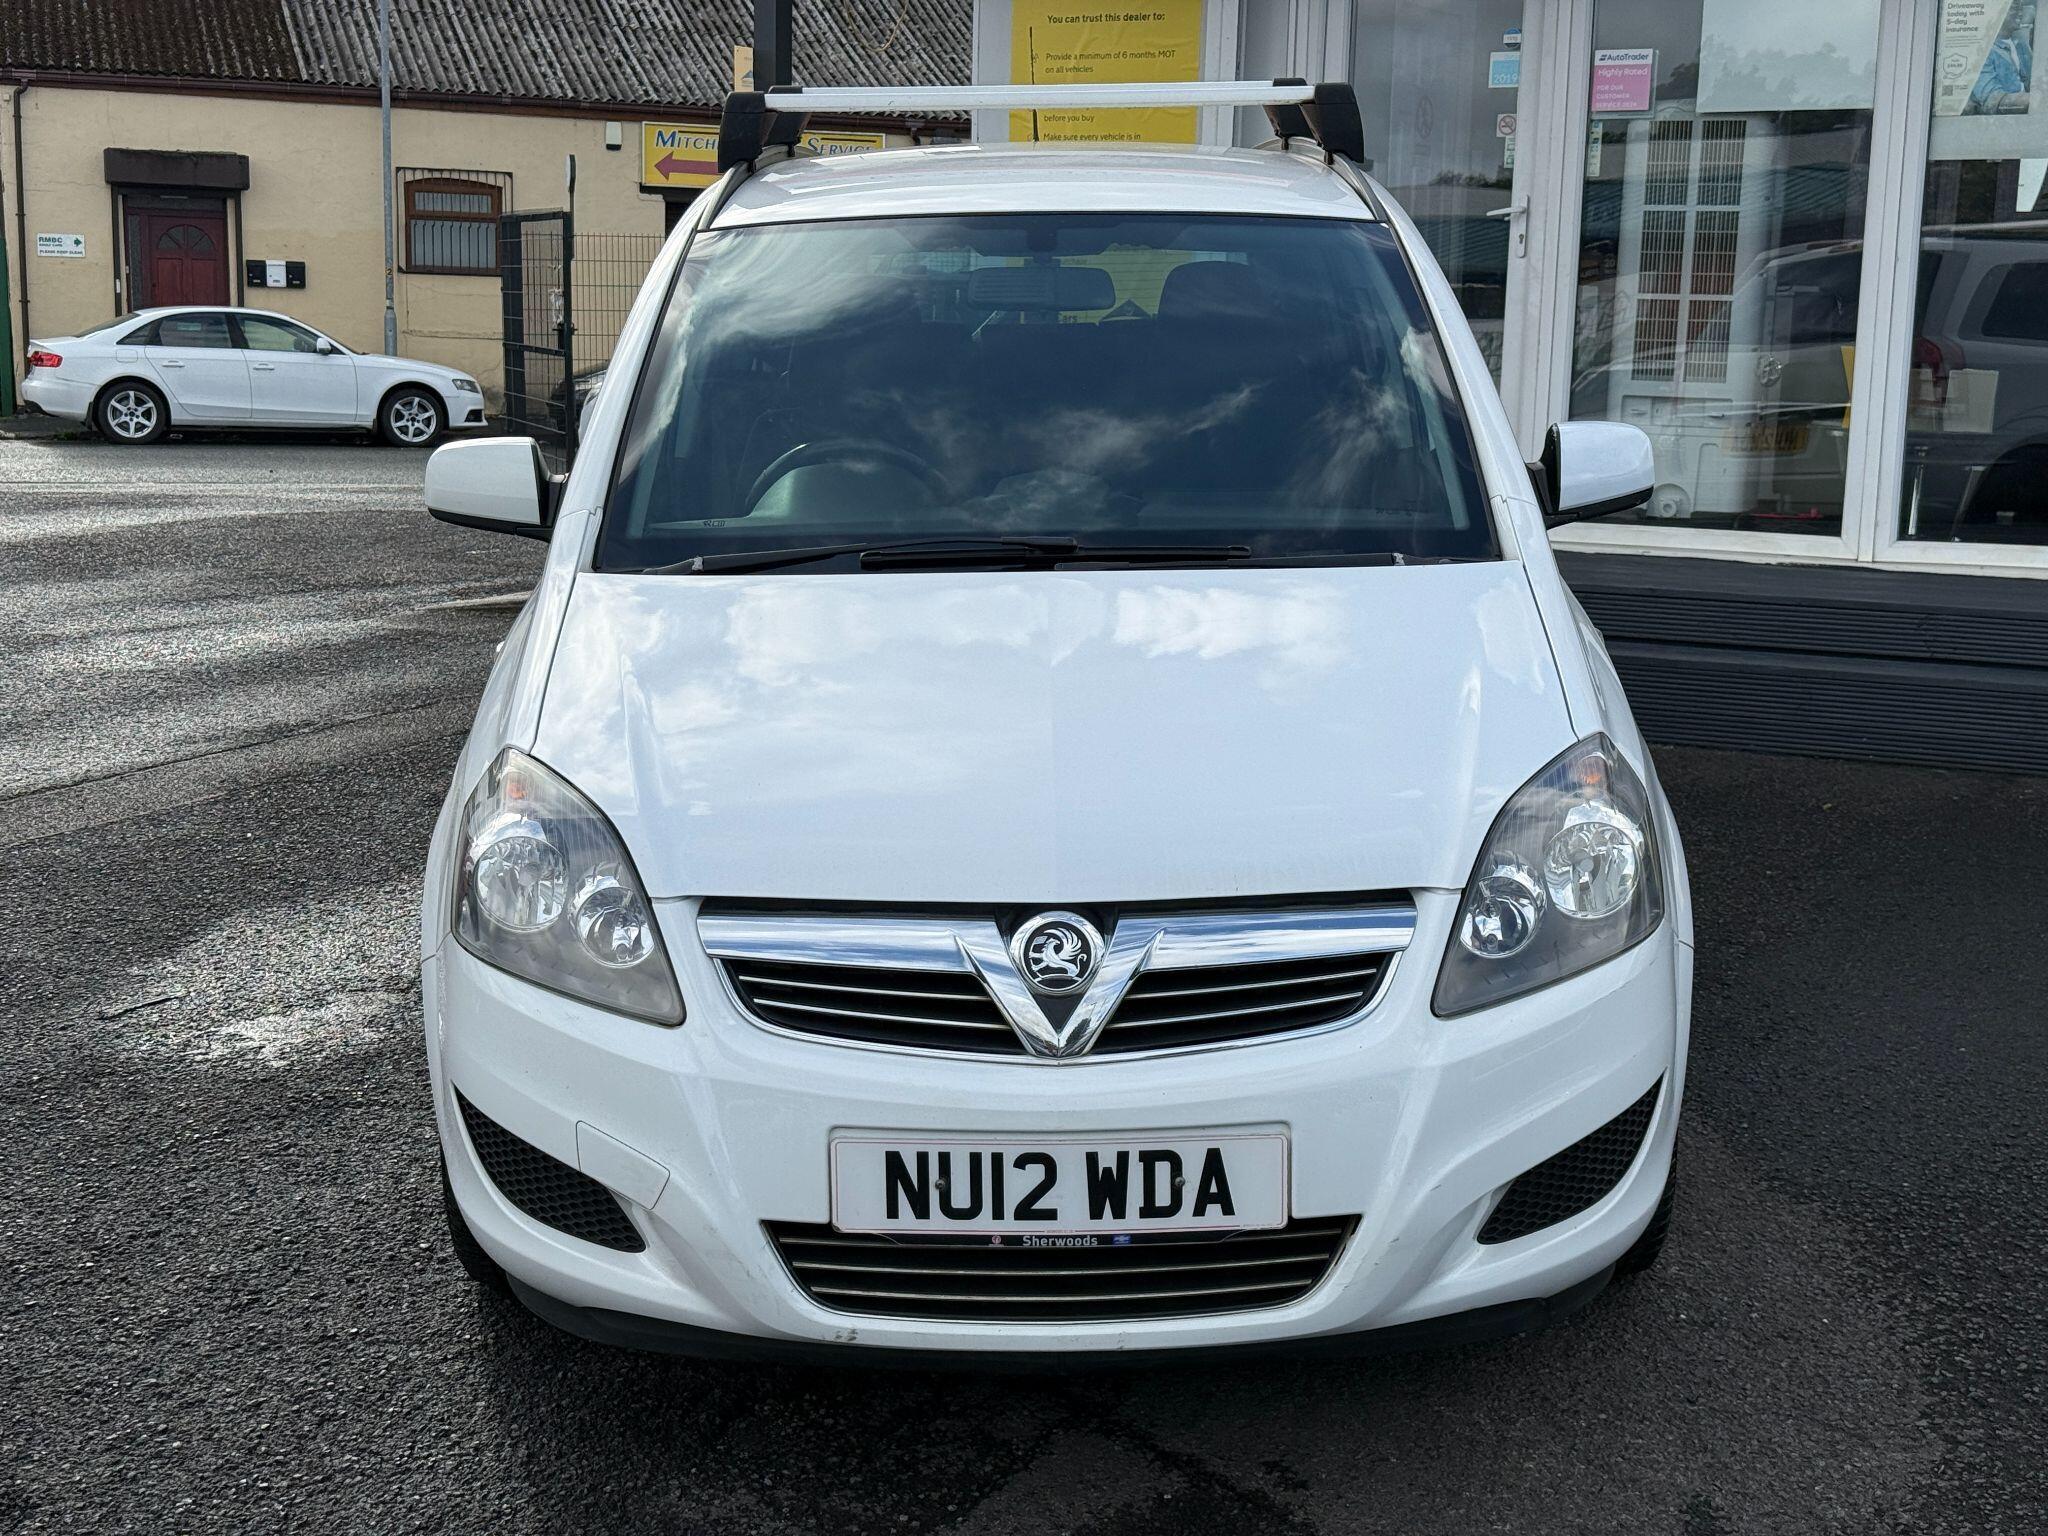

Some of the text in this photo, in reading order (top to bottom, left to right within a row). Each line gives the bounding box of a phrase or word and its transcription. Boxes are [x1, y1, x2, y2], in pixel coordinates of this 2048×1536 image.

[1047, 15, 1063, 23] You
[1082, 14, 1102, 22] trust
[1105, 13, 1121, 21] this
[1123, 13, 1151, 21] dealer
[1079, 52, 1112, 60] minimum
[1113, 51, 1121, 59] of
[1122, 51, 1128, 59] 6
[1129, 51, 1157, 59] months
[1158, 50, 1176, 58] MOT
[1607, 53, 1650, 61] AutoTrader
[1065, 65, 1094, 73] vehicles
[1598, 69, 1622, 77] Highly
[1494, 73, 1518, 84] 2019
[656, 130, 719, 149] MITCH
[1043, 133, 1062, 141] Make
[1100, 133, 1125, 141] vehicle
[1085, 1147, 1236, 1221] WDA
[1022, 1235, 1098, 1246] Sherwoods
